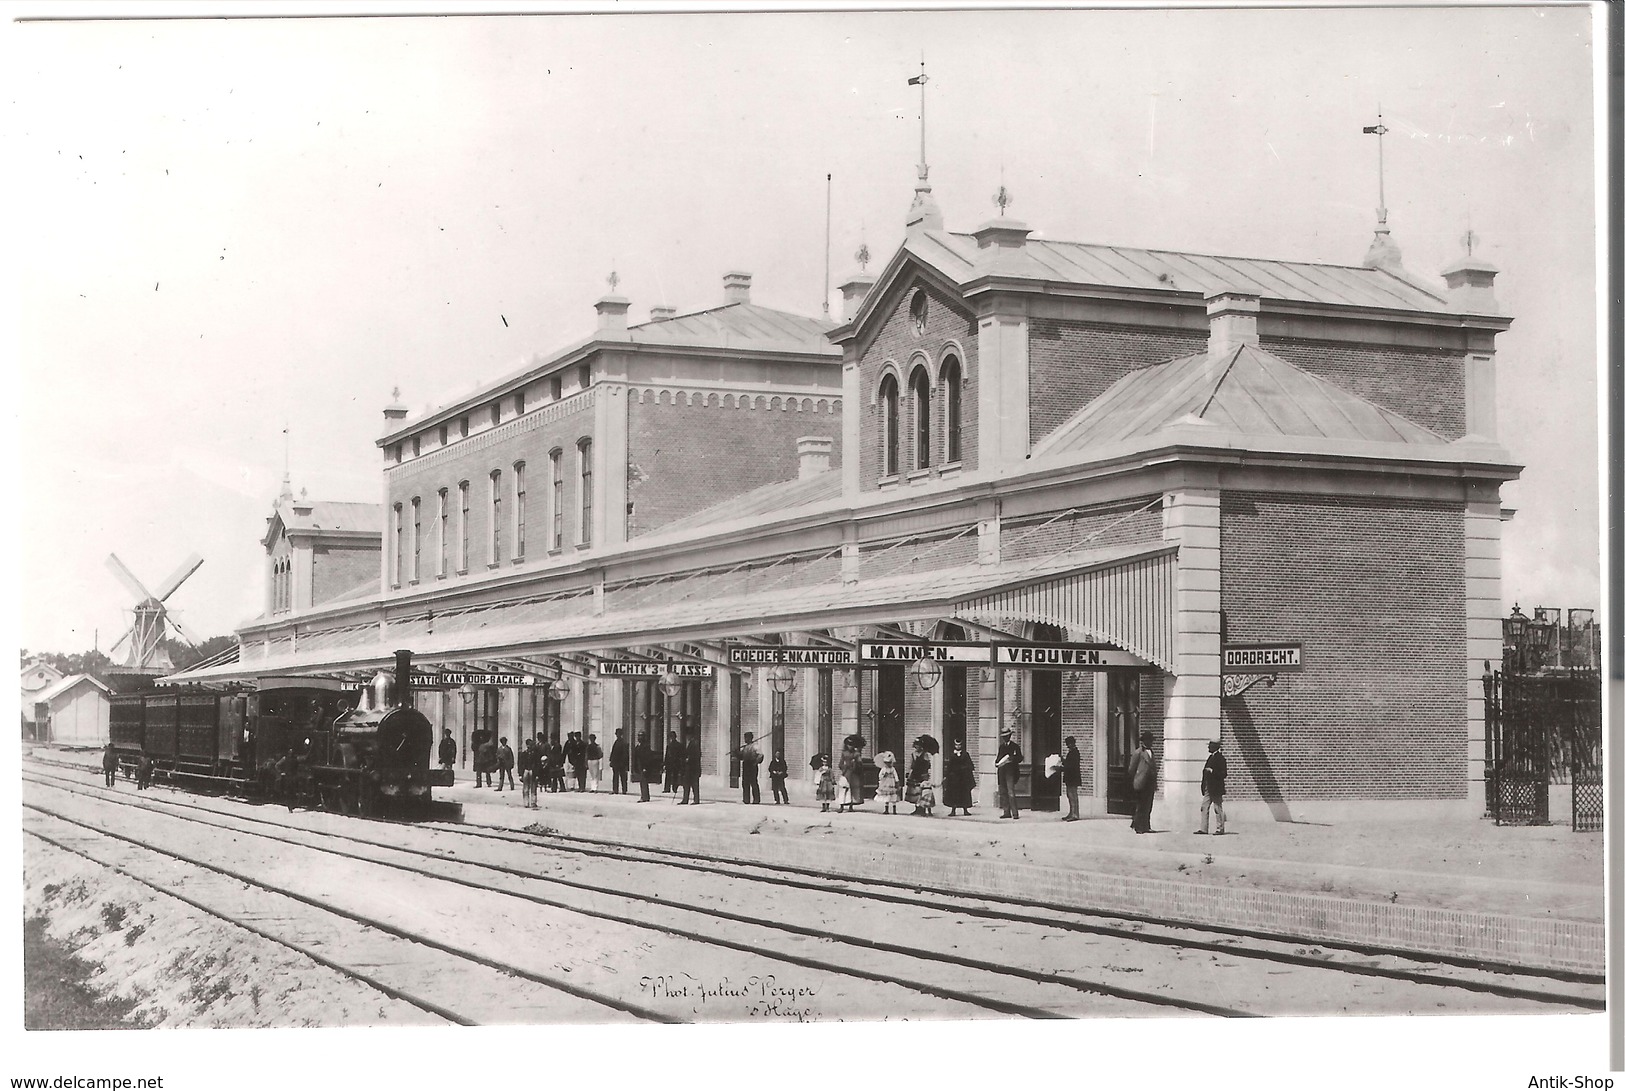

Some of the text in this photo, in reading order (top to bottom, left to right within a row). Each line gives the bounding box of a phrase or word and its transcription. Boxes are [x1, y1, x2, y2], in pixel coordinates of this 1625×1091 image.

[870, 645, 954, 660] MANNEN.
[1008, 648, 1108, 665] VROUWEN.
[1227, 650, 1298, 664] DORDRECHT.
[670, 665, 711, 676] LASSE.
